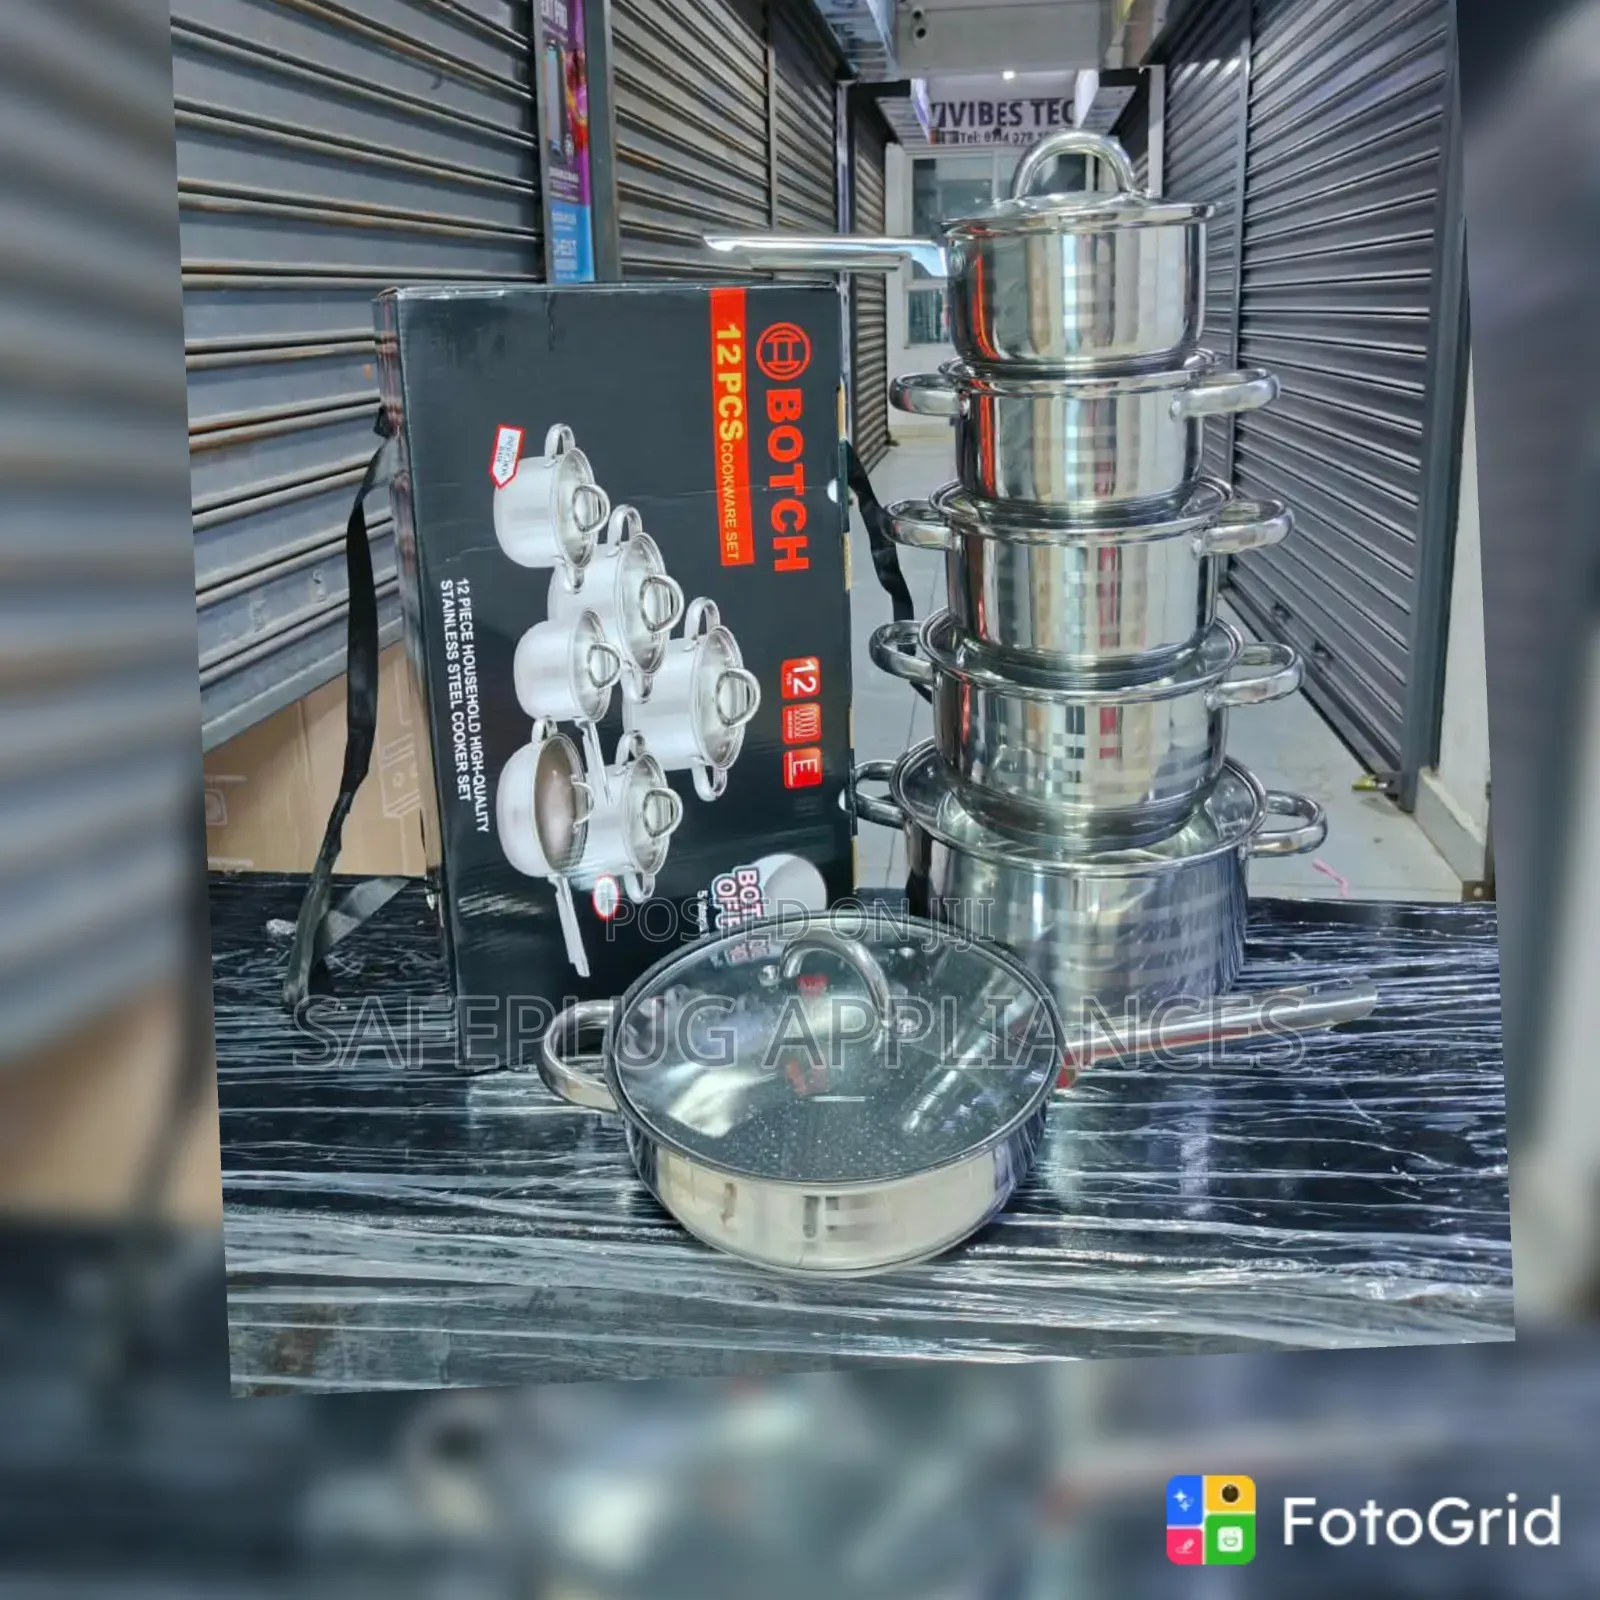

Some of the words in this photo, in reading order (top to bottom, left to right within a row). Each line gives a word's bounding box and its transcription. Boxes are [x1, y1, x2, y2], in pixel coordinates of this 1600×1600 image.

[716, 324, 742, 365] 12
[717, 372, 743, 440] PCS
[720, 441, 737, 528] COOKWARE
[766, 387, 809, 571] BOTCH
[725, 531, 740, 560] SET
[456, 578, 470, 594] 12
[440, 579, 458, 660] STAINLESS
[458, 597, 474, 642] PIECE
[447, 663, 463, 710] STEEL
[462, 643, 481, 733] HOUSEHOLD
[792, 660, 817, 696] 12
[451, 711, 469, 773] COOKER
[457, 776, 472, 802] SET
[469, 735, 489, 833] HIGH-QUALITY
